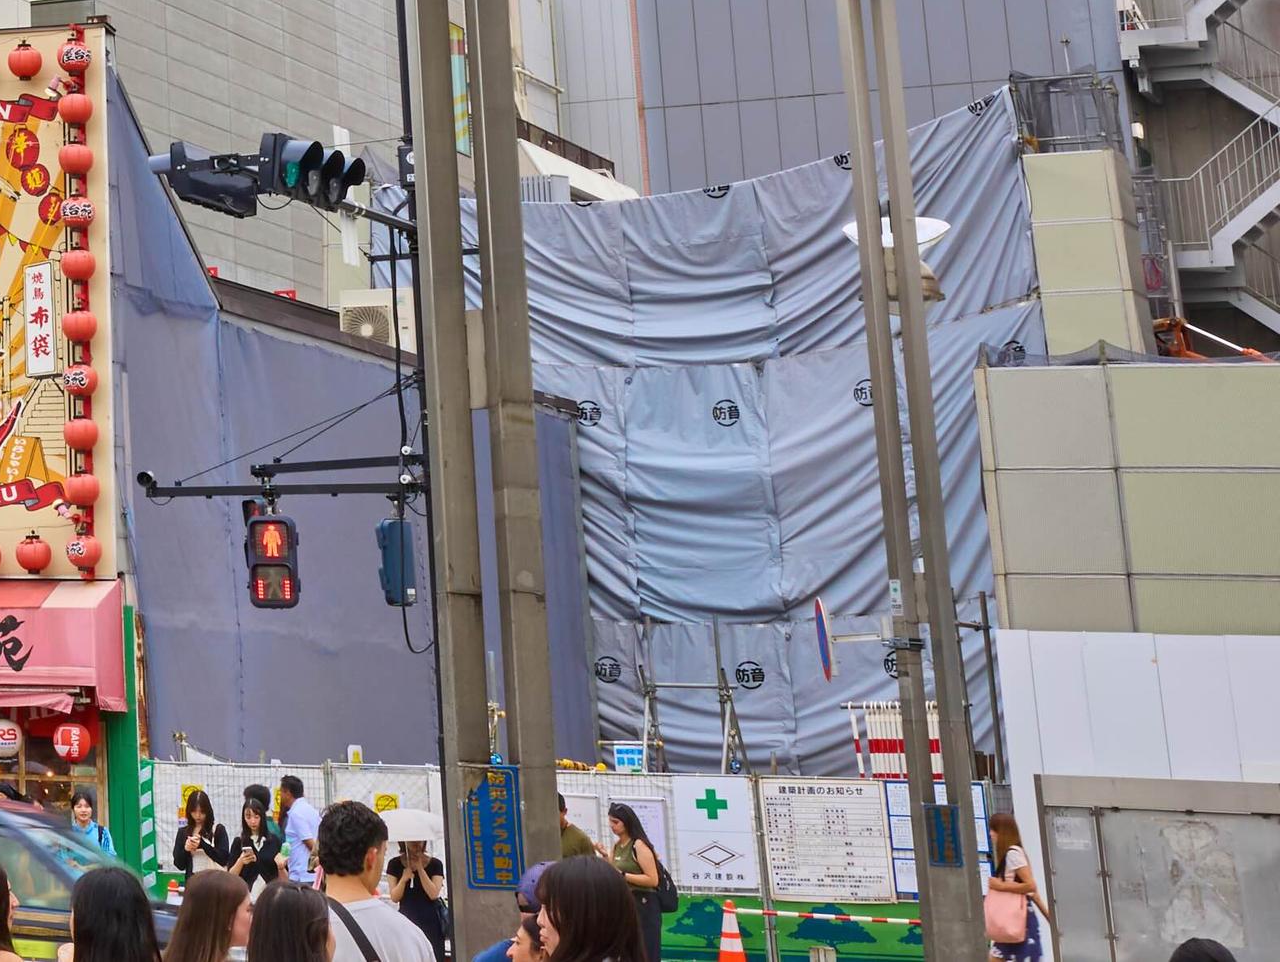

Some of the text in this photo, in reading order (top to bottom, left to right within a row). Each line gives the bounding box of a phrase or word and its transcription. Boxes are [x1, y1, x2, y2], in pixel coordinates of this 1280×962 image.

[712, 404, 741, 423] 防音
[594, 662, 622, 679] 防音
[735, 668, 766, 684] 防音
[778, 785, 864, 796] 建築計画のお知らせ
